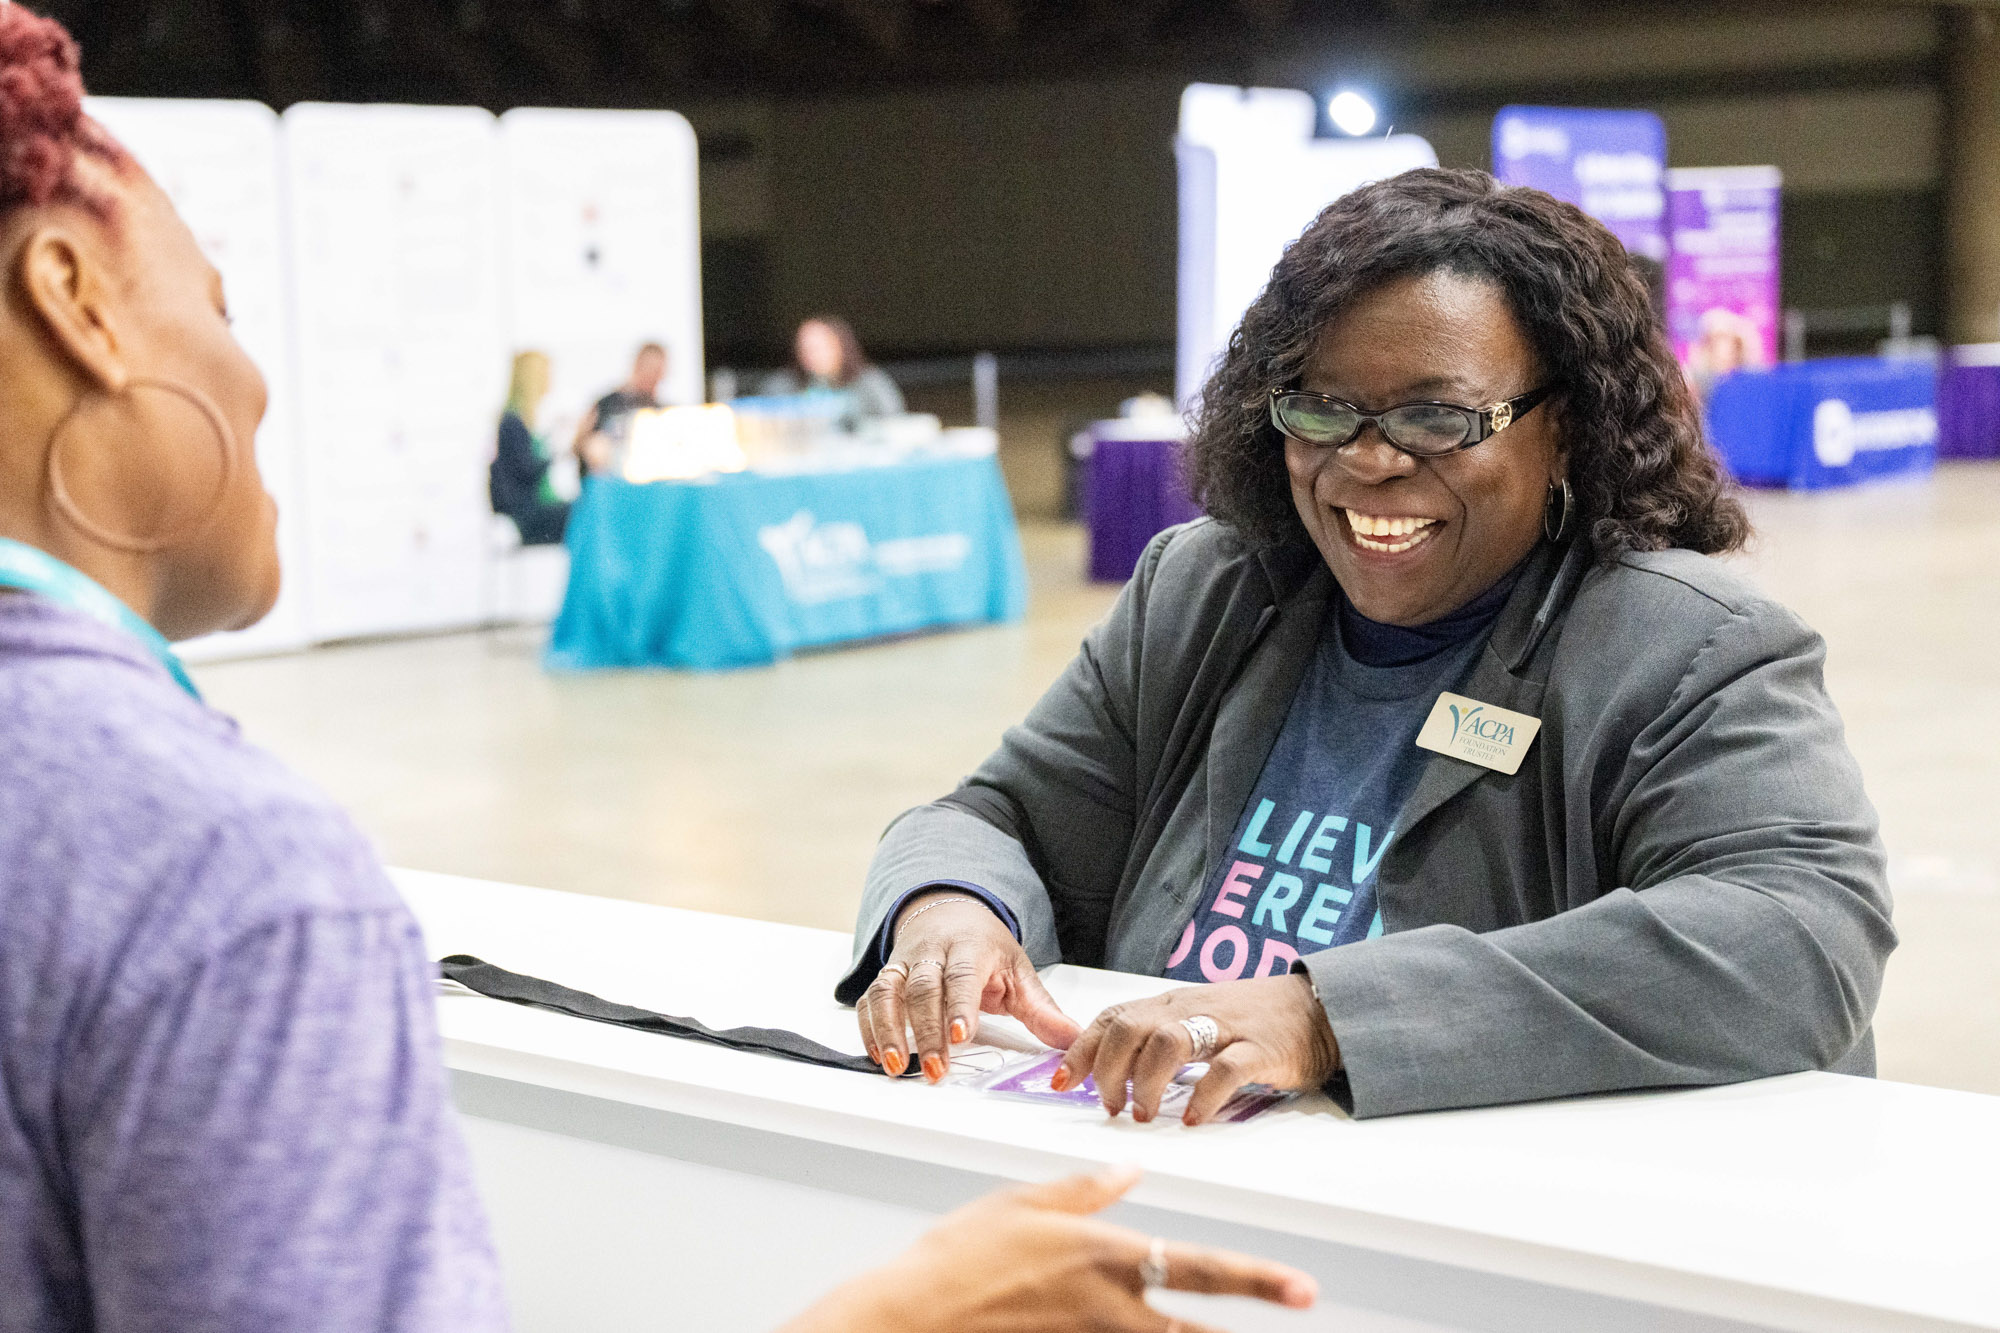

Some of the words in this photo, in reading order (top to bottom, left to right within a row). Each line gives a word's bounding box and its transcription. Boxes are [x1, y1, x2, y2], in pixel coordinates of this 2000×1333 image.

[1463, 716, 1515, 746] ACPA
[1459, 737, 1507, 756] FOUNDATION
[1463, 747, 1496, 761] TRUSTEE
[1237, 797, 1395, 884] LIEV
[1210, 860, 1354, 945] ERE
